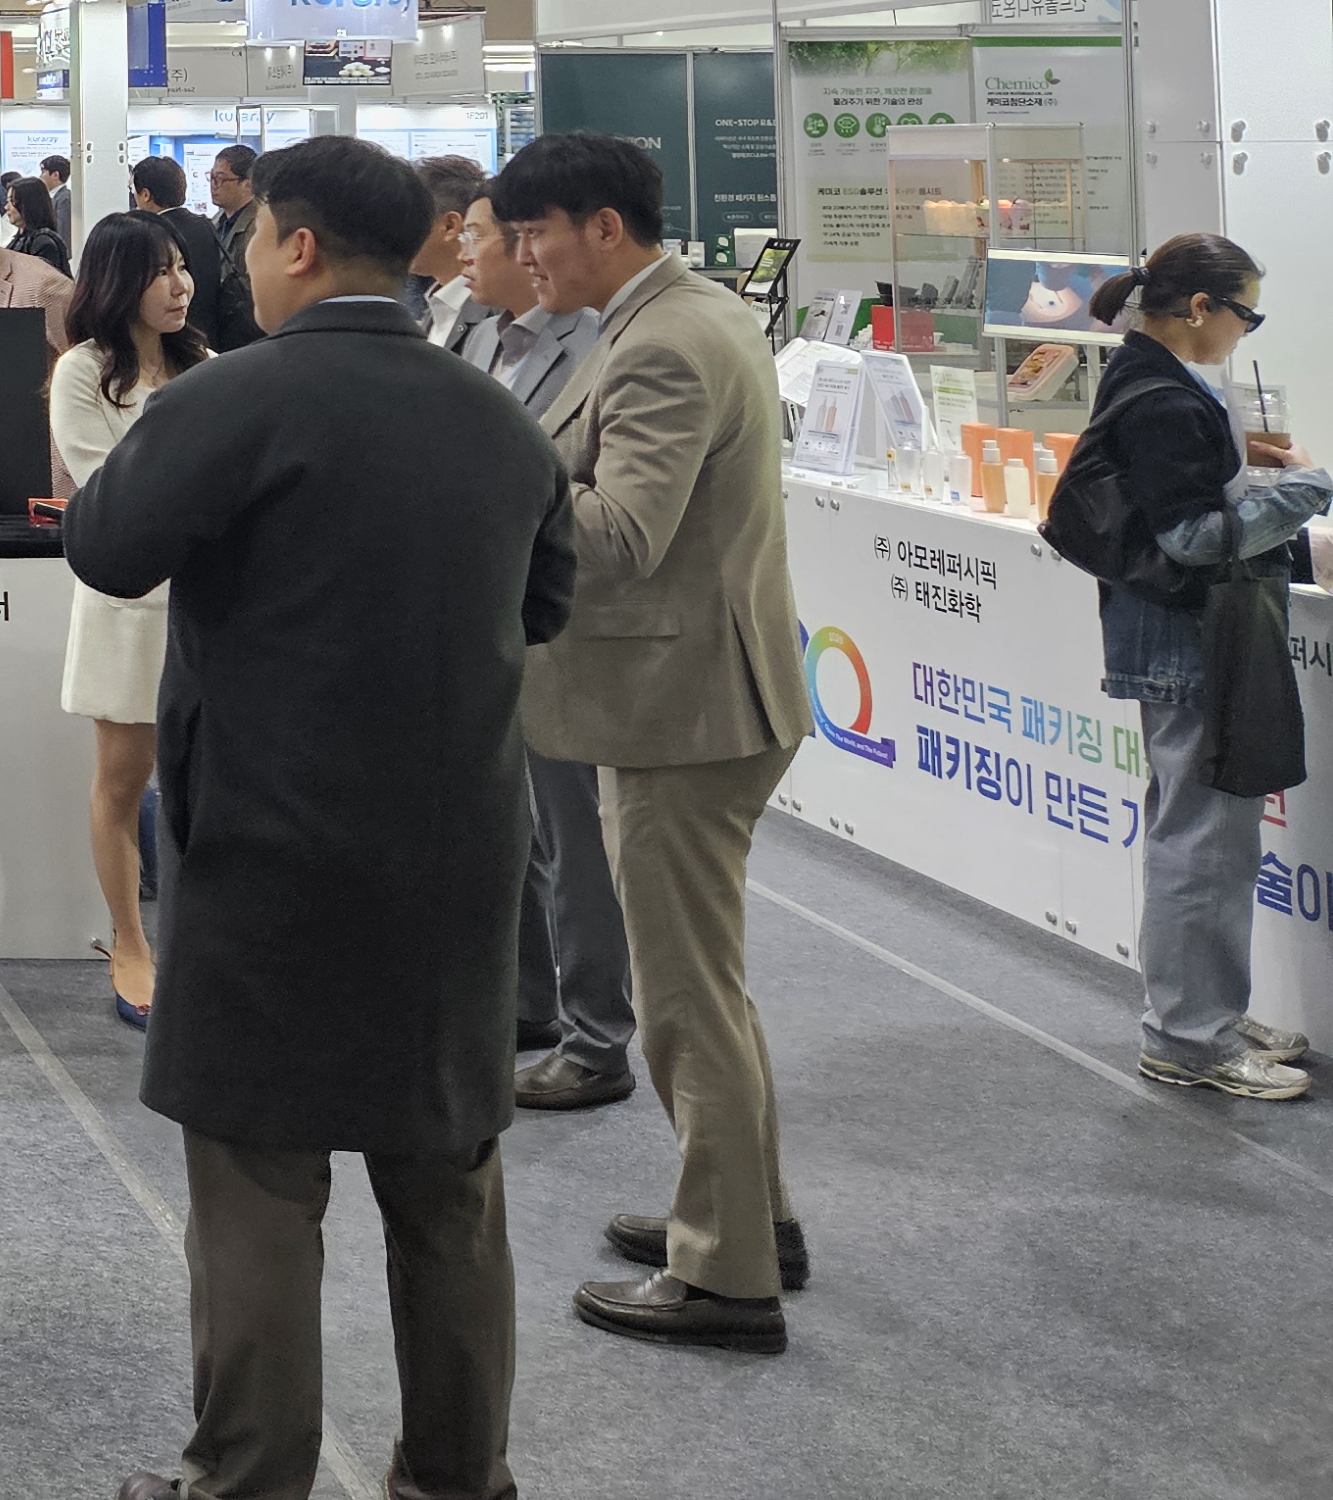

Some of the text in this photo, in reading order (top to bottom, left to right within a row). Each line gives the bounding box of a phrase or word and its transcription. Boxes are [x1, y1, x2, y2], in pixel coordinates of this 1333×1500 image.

[985, 77, 1049, 90] Chemico
[986, 98, 1043, 107] 케미코첨단소재
[714, 118, 759, 127] ONE-STOP
[873, 534, 997, 590] (주) 아모레퍼시픽
[891, 573, 982, 623] (주) 태진화학
[912, 661, 1013, 735] 대한민국
[1020, 695, 1104, 765] 패키징
[915, 723, 1110, 845] 패키징이 만든
